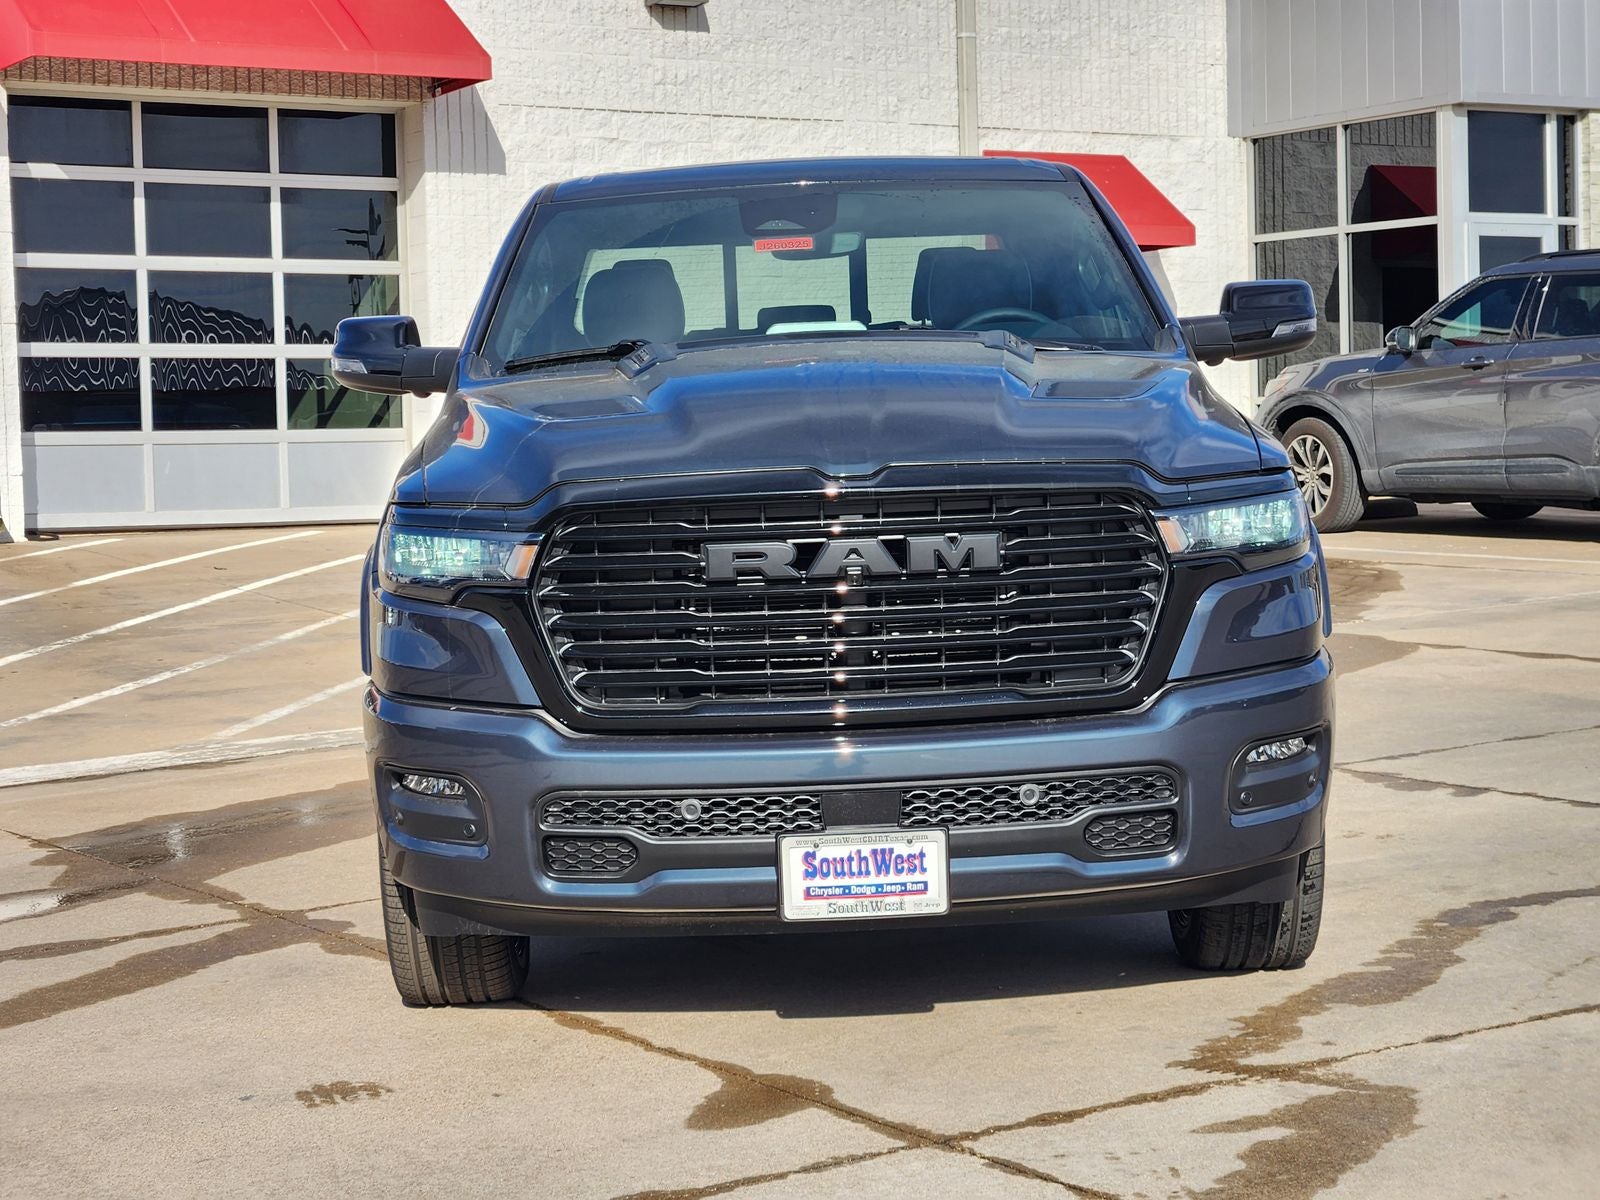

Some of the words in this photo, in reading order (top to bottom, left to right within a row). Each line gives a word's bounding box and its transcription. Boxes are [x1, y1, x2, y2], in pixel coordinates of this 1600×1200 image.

[702, 533, 1003, 581] RAM
[802, 847, 928, 880] SouthWest
[809, 886, 843, 897] Chrysler
[850, 885, 876, 895] Dodge
[882, 884, 902, 894] Jeep
[906, 882, 925, 892] Ram
[828, 900, 905, 914] SouthWest
